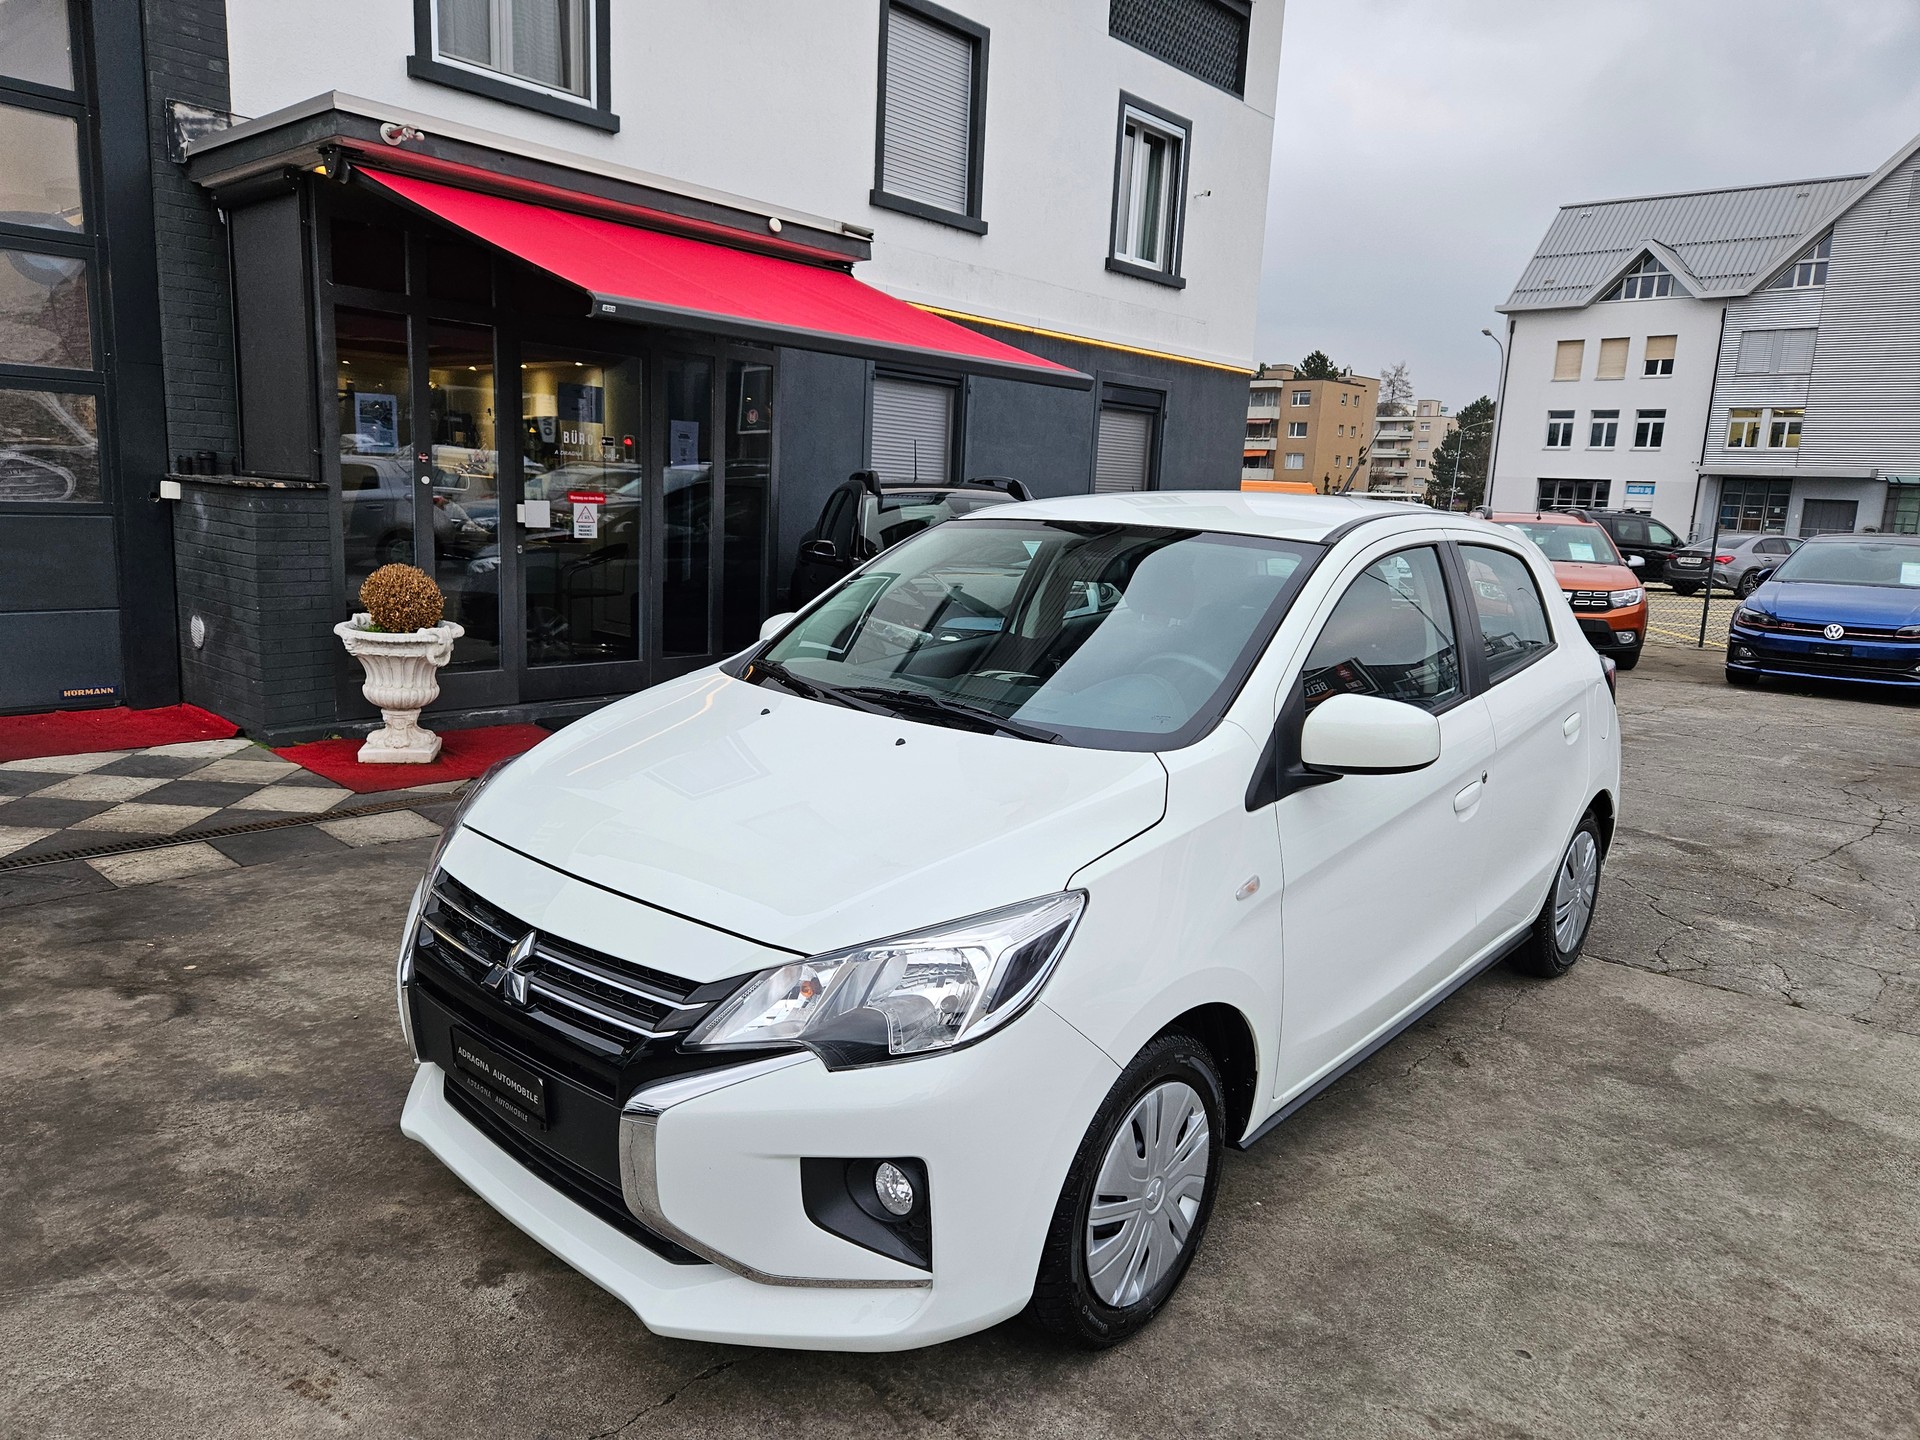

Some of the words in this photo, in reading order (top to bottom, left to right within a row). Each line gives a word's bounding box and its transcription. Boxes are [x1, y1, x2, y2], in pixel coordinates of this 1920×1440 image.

[563, 430, 593, 446] BÜRO
[458, 1046, 490, 1072] ADRAGNA
[492, 1069, 538, 1104] AUTOMOBILE
